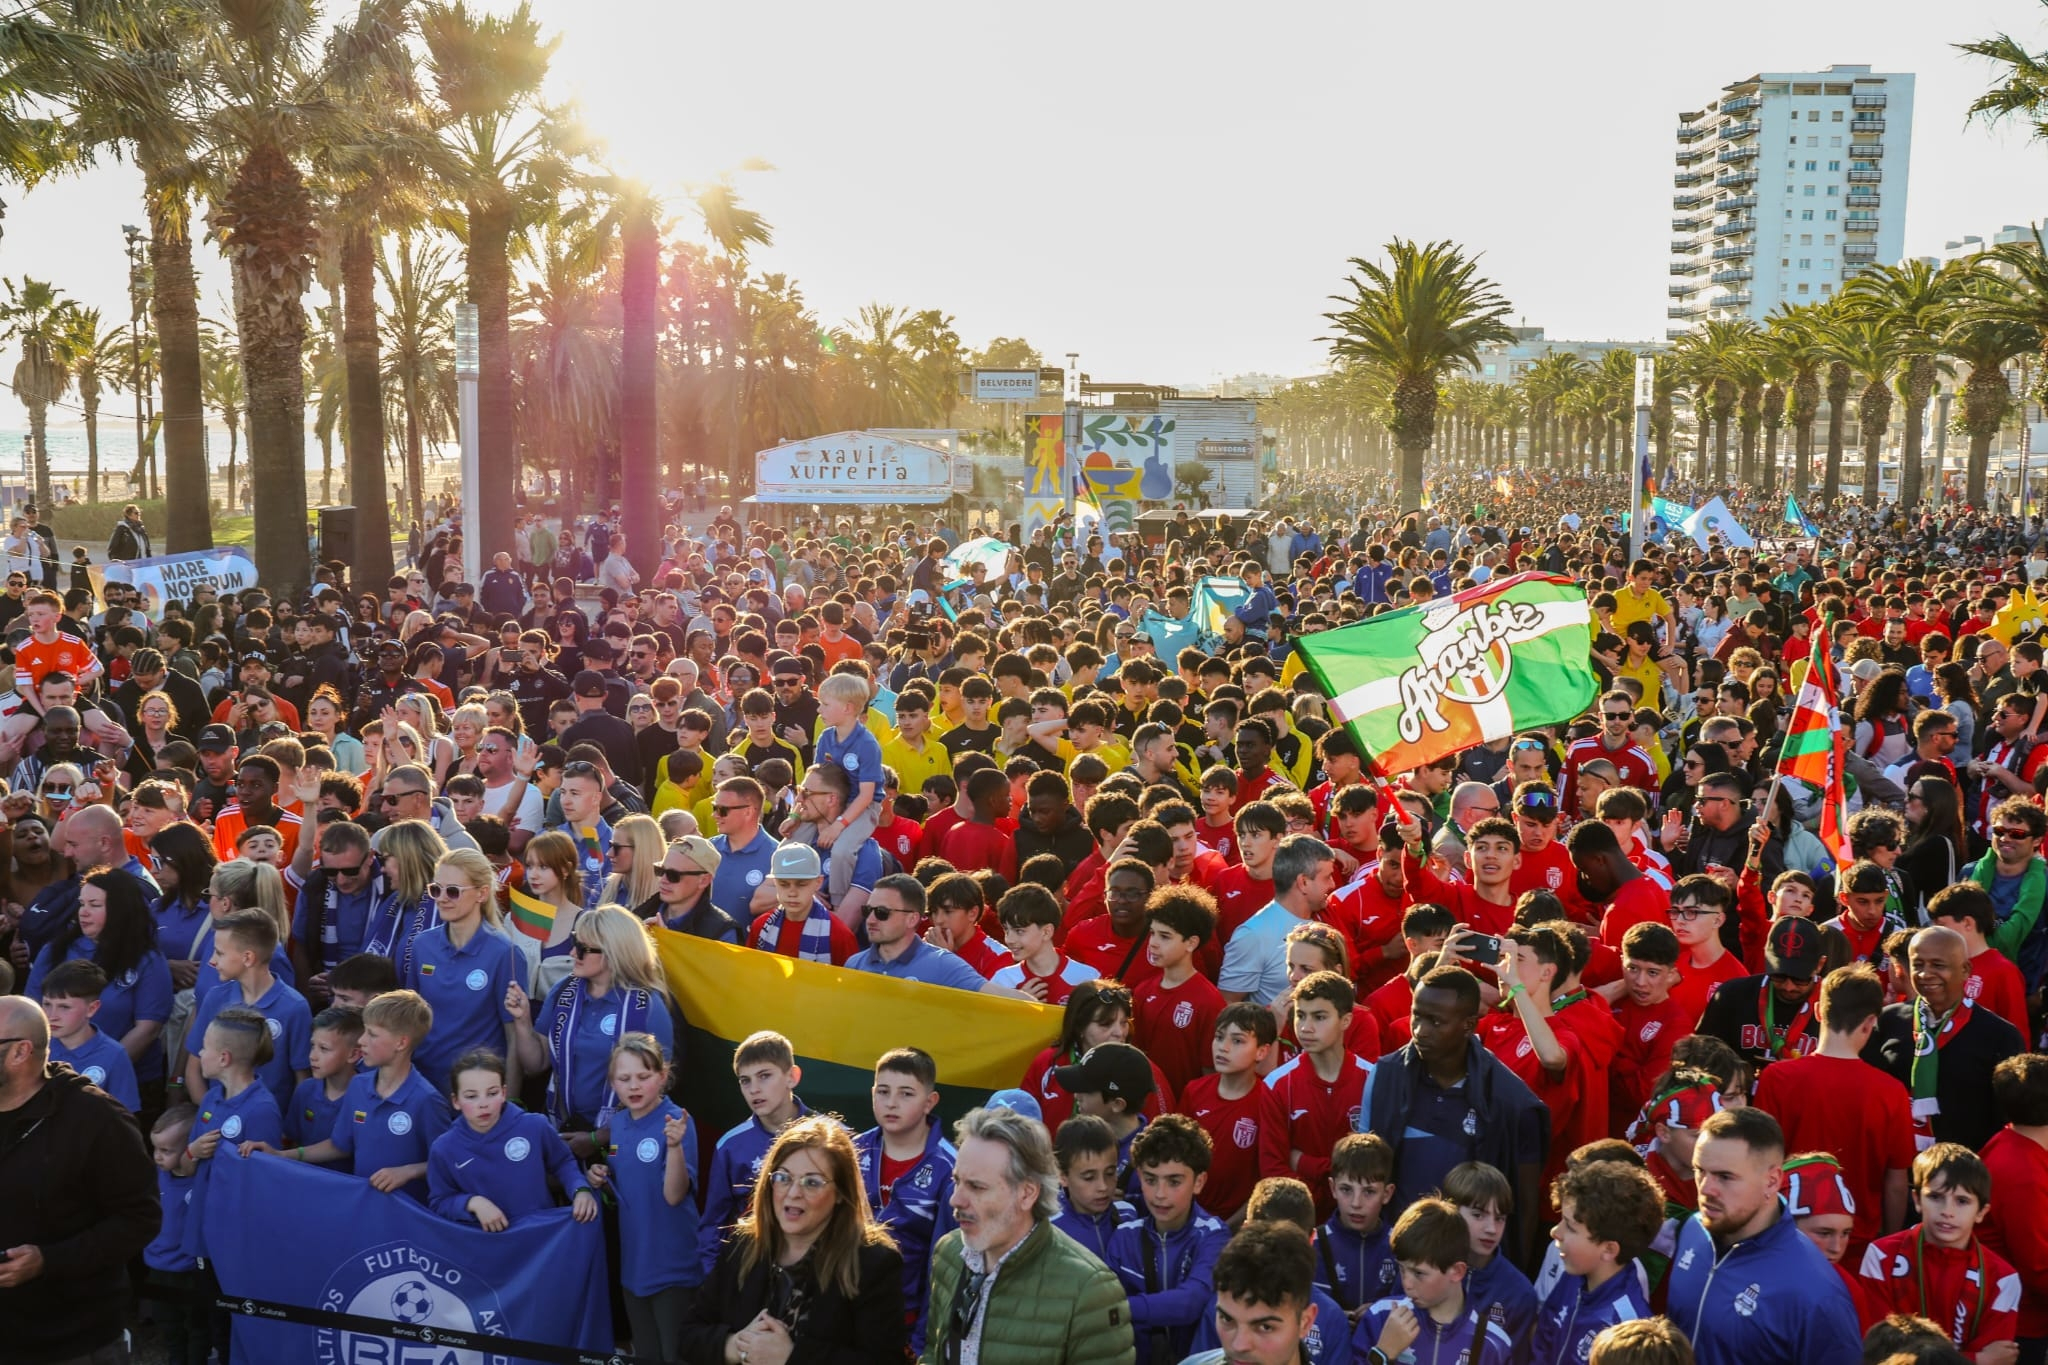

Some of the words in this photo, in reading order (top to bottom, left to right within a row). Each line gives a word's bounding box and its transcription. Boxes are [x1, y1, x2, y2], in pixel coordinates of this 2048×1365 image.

[980, 379, 1033, 387] BELVEDERE
[819, 445, 874, 464] xavi
[1205, 445, 1247, 454] BELVEDERE
[789, 462, 908, 481] xurreria
[159, 560, 209, 582] MARE
[363, 1247, 462, 1285] FUTBOLO
